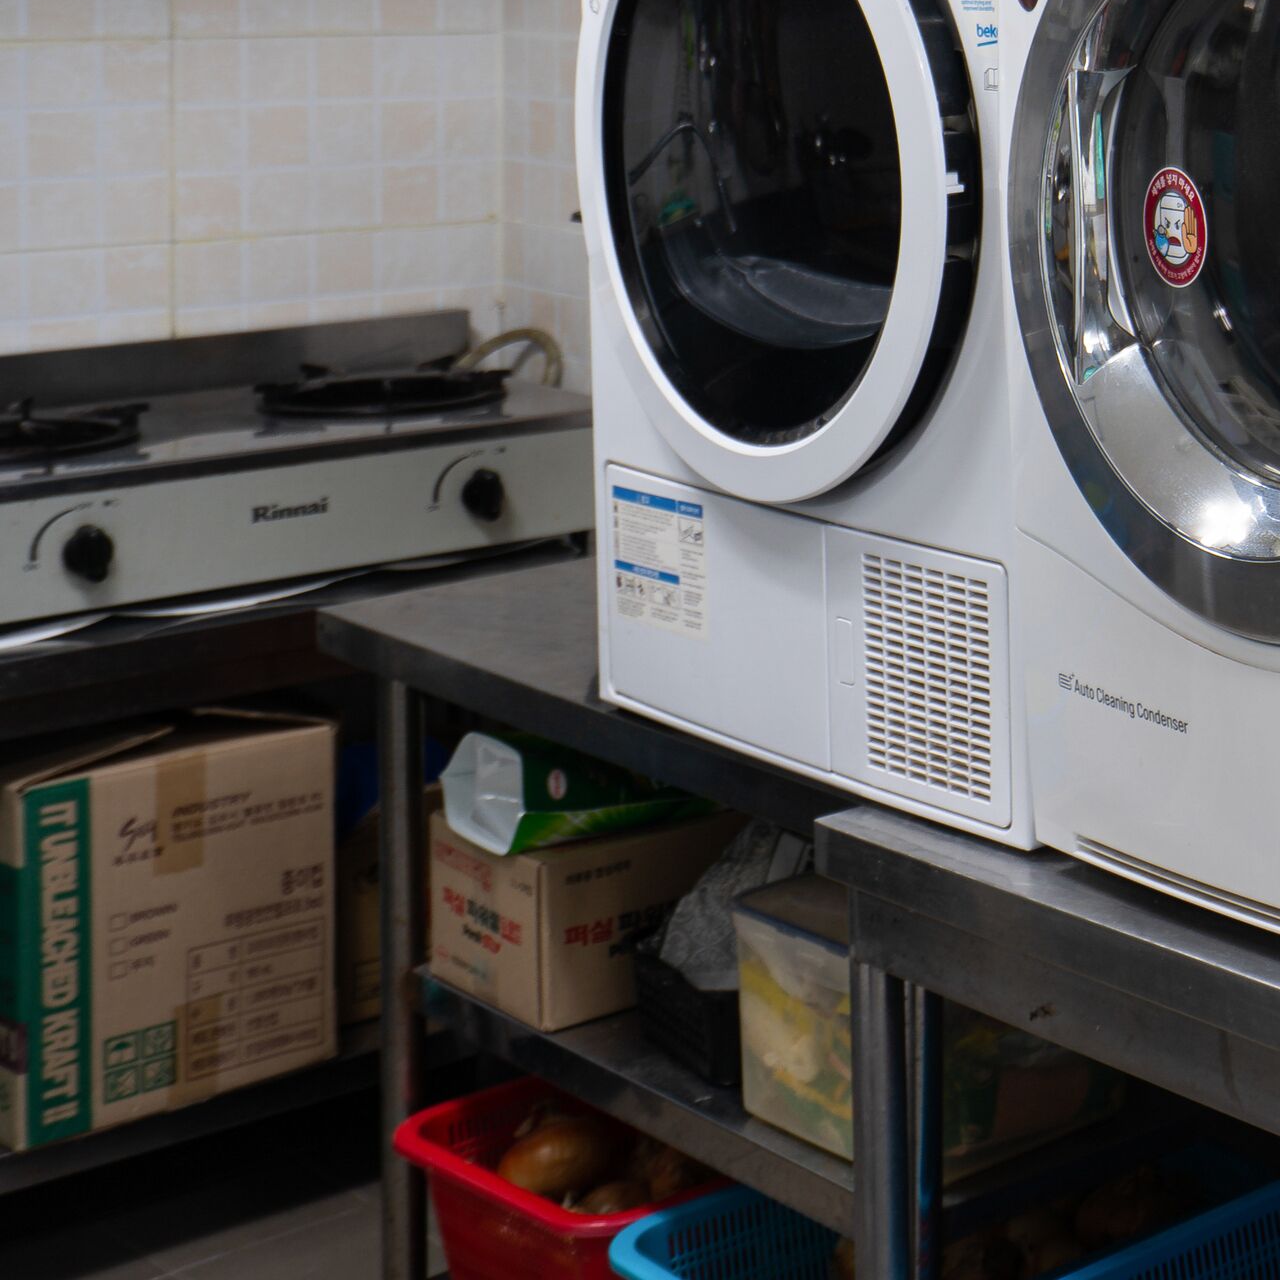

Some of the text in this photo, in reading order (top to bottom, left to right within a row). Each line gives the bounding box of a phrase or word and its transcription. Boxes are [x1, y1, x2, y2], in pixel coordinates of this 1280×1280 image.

[252, 496, 329, 523] Rinnai
[1074, 679, 1188, 734] Auto Cleaning Condenser
[40, 829, 79, 1008] UNBLEACHED
[564, 916, 614, 946] 퍼실
[41, 1009, 79, 1101] KRAFT
